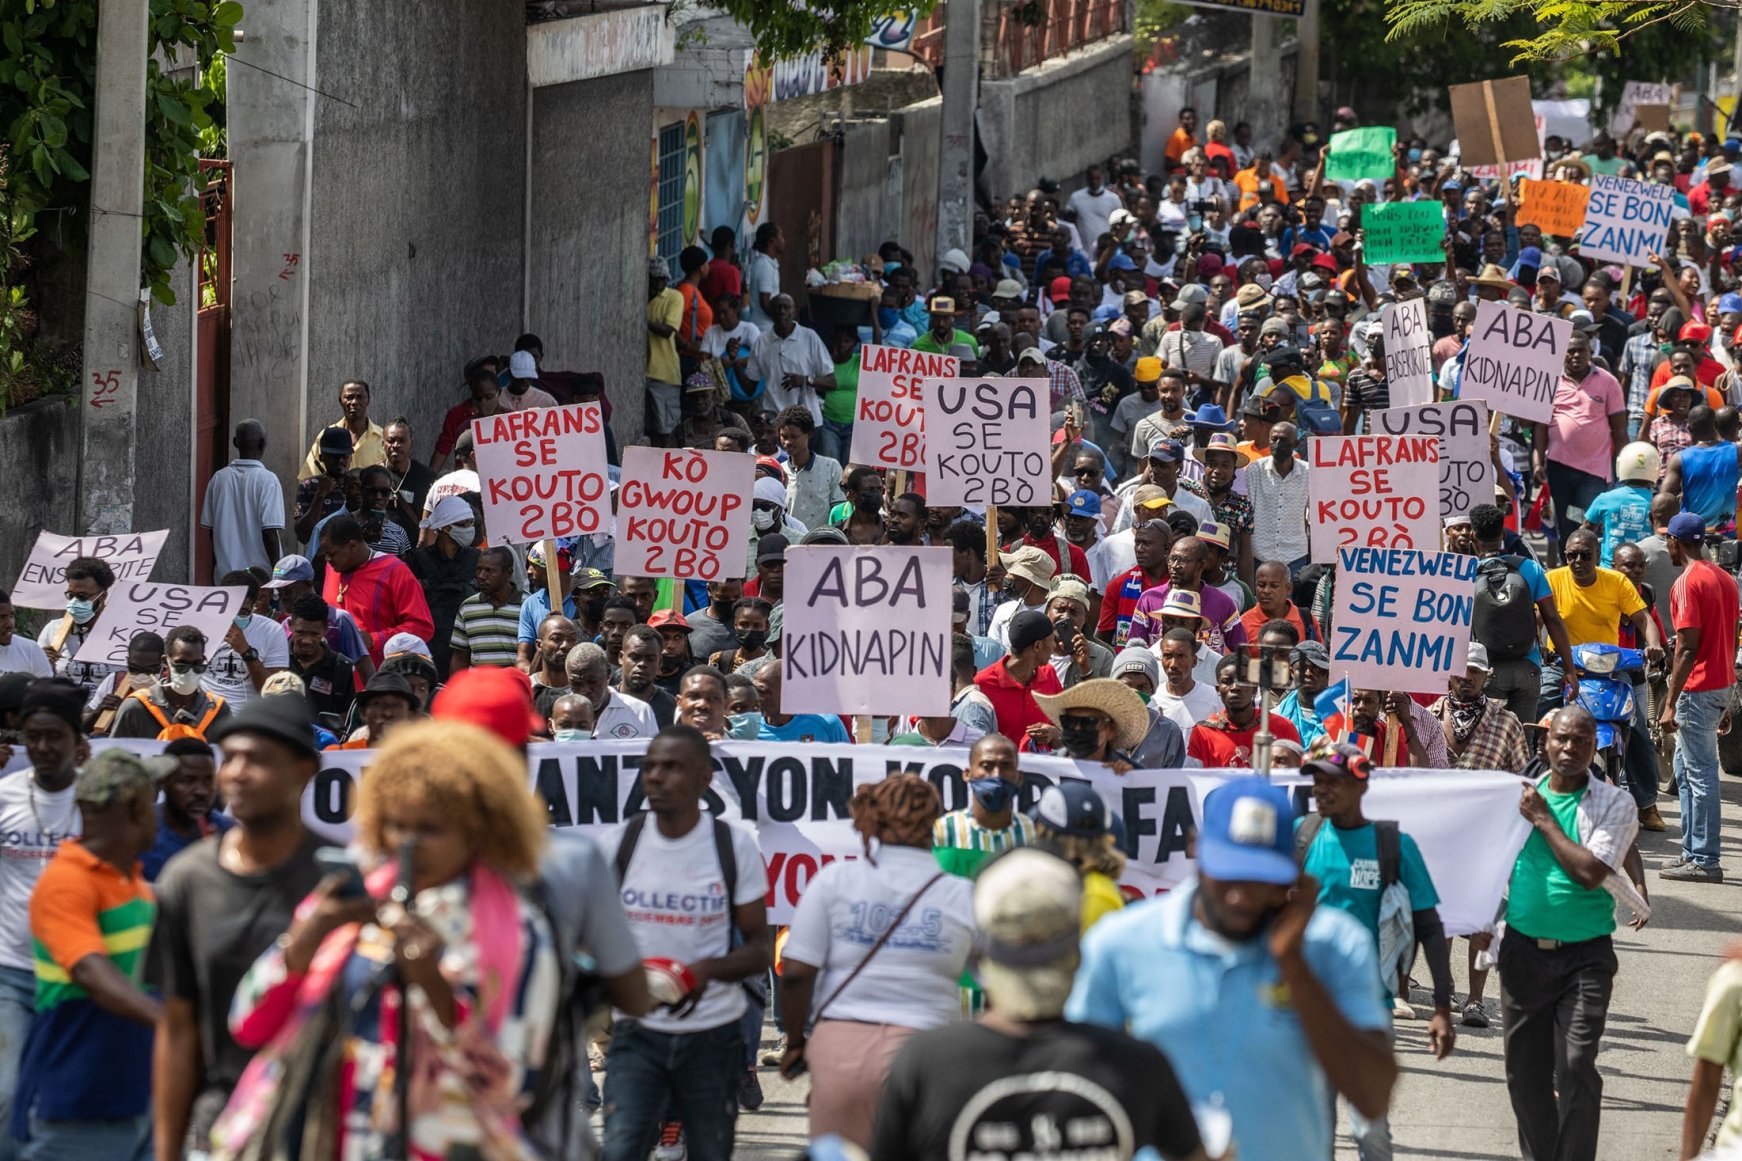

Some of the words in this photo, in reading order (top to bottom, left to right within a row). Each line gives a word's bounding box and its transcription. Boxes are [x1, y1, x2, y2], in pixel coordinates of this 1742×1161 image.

[1595, 174, 1677, 200] VENEZWELA
[1589, 191, 1619, 217] SE
[1622, 195, 1673, 228] BON
[1581, 221, 1664, 257] ZANMI
[283, 253, 300, 267] 35
[1391, 303, 1423, 340] ABA
[1482, 309, 1556, 355] ABA
[862, 345, 956, 378] LAFRANS
[1386, 344, 1432, 385] ENSEKIRITE
[92, 370, 122, 395] 35
[891, 375, 923, 400] SE
[1464, 353, 1560, 405] KIDNAPIN
[860, 397, 925, 432] KOUT
[937, 383, 1037, 420] USA
[475, 406, 600, 445] LAFRANS
[952, 422, 1003, 450] SE
[1382, 404, 1479, 436] USA
[514, 438, 557, 467] SE
[878, 431, 926, 467] 2B
[937, 451, 1044, 479] KOUTO
[1315, 437, 1439, 467] LAFRANS
[662, 450, 708, 483] KÒ
[1350, 469, 1393, 495] SE
[489, 470, 604, 505] KOUTO
[621, 480, 742, 522] GWOUP
[963, 477, 1034, 505] 2BÒ
[1439, 486, 1470, 516] BÒ
[519, 501, 600, 539] 2BÒ
[1318, 496, 1425, 524] KOUTO
[53, 536, 143, 559] ABA
[626, 516, 729, 551] KOUTO
[644, 546, 720, 579] 2BÒ
[1340, 547, 1479, 583] VENEZWELA
[128, 583, 230, 614] USA
[807, 555, 926, 609] ABA
[136, 607, 183, 628] SE
[1349, 581, 1400, 618] SE
[1412, 588, 1473, 627] BON
[786, 629, 944, 681] KIDNAPIN
[1334, 626, 1455, 672] ZANMI
